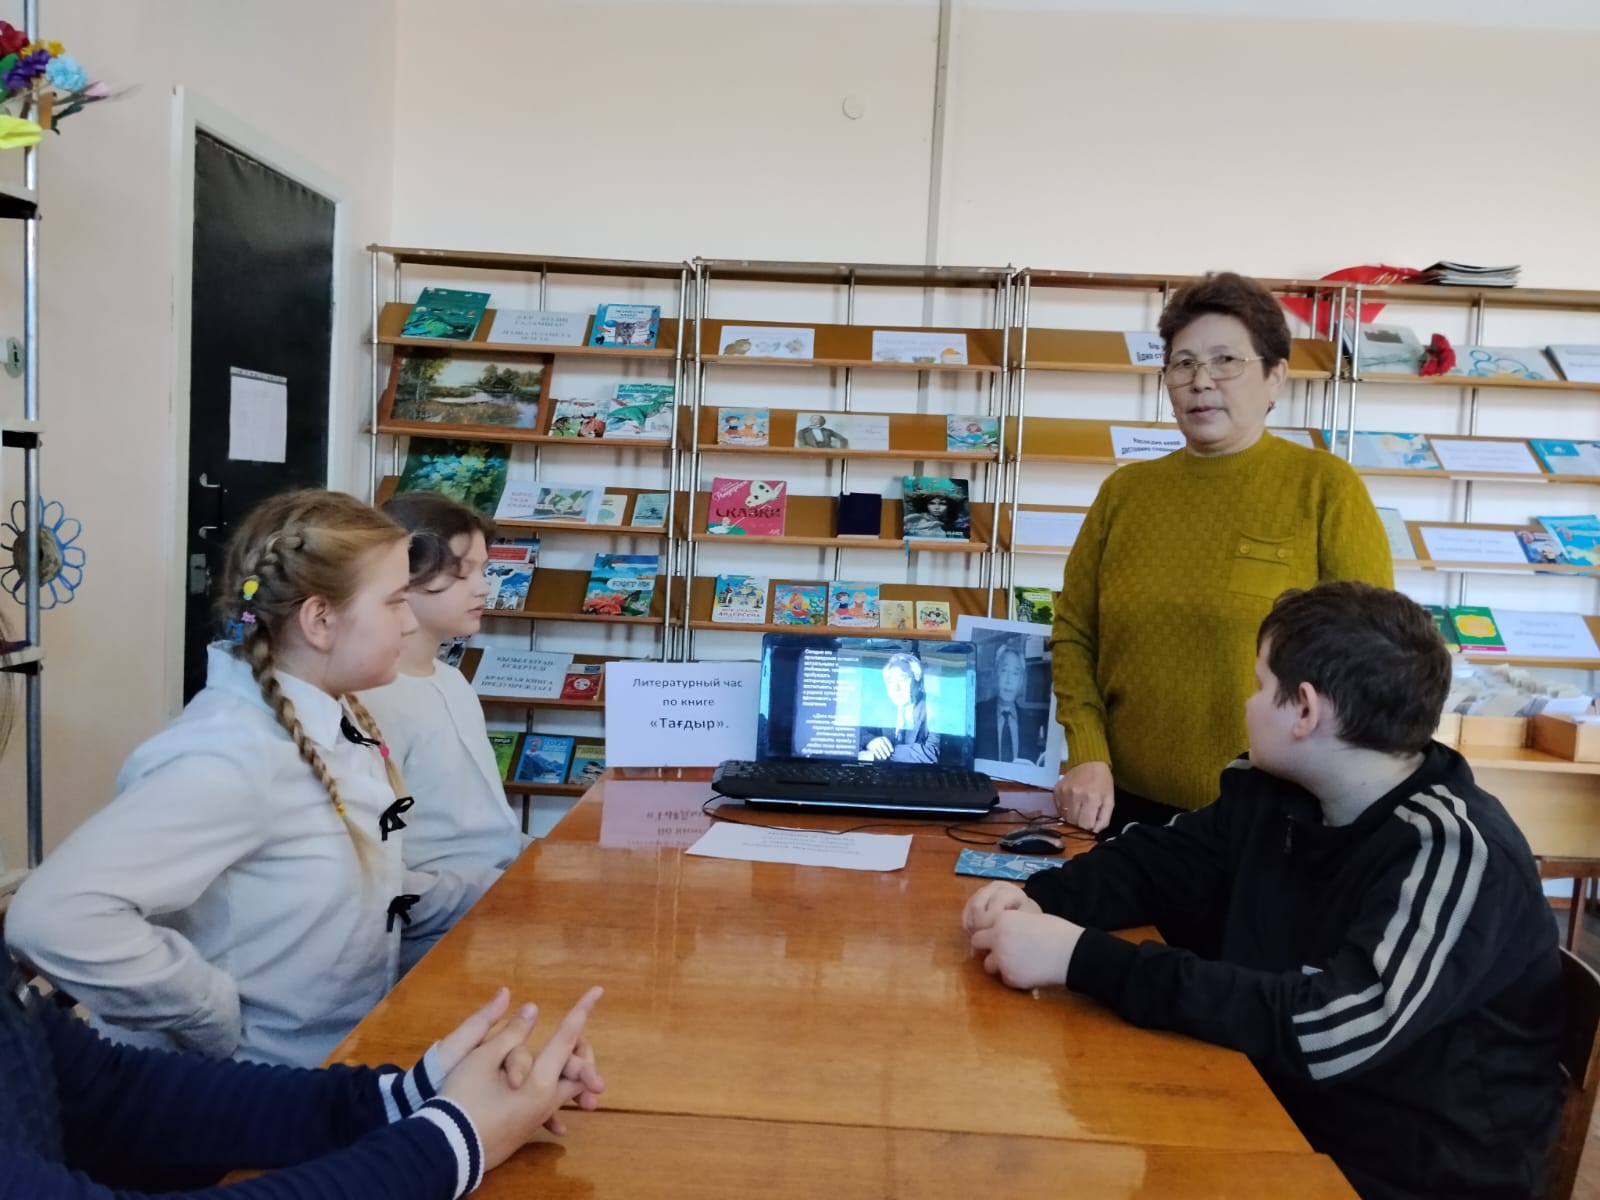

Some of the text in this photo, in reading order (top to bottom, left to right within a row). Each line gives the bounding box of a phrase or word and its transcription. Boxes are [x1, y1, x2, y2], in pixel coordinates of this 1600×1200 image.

[716, 507, 781, 519] СКАЗКИ
[632, 678, 743, 688] Литературный час
[650, 717, 729, 731] «Тағдыр».
